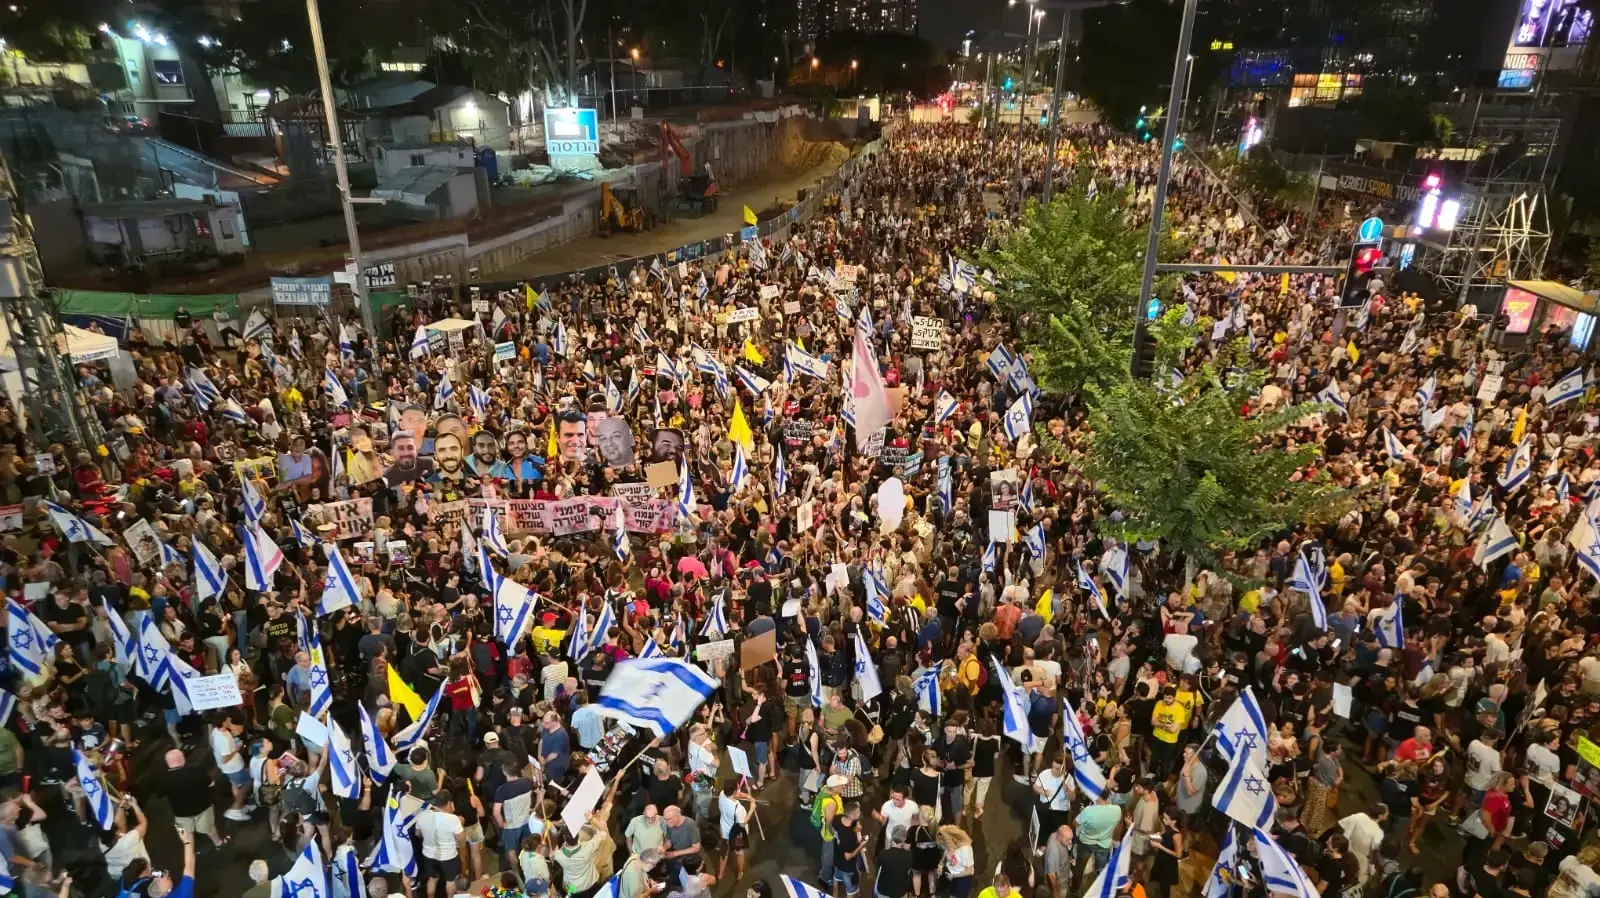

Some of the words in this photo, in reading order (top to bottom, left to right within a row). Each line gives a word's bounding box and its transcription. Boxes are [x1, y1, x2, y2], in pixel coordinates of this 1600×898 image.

[551, 141, 598, 153] הנדסה
[1338, 175, 1367, 192] AZRIELI
[1368, 179, 1394, 198] SPIRAL
[334, 502, 360, 521] אין
[516, 511, 541, 520] שלא
